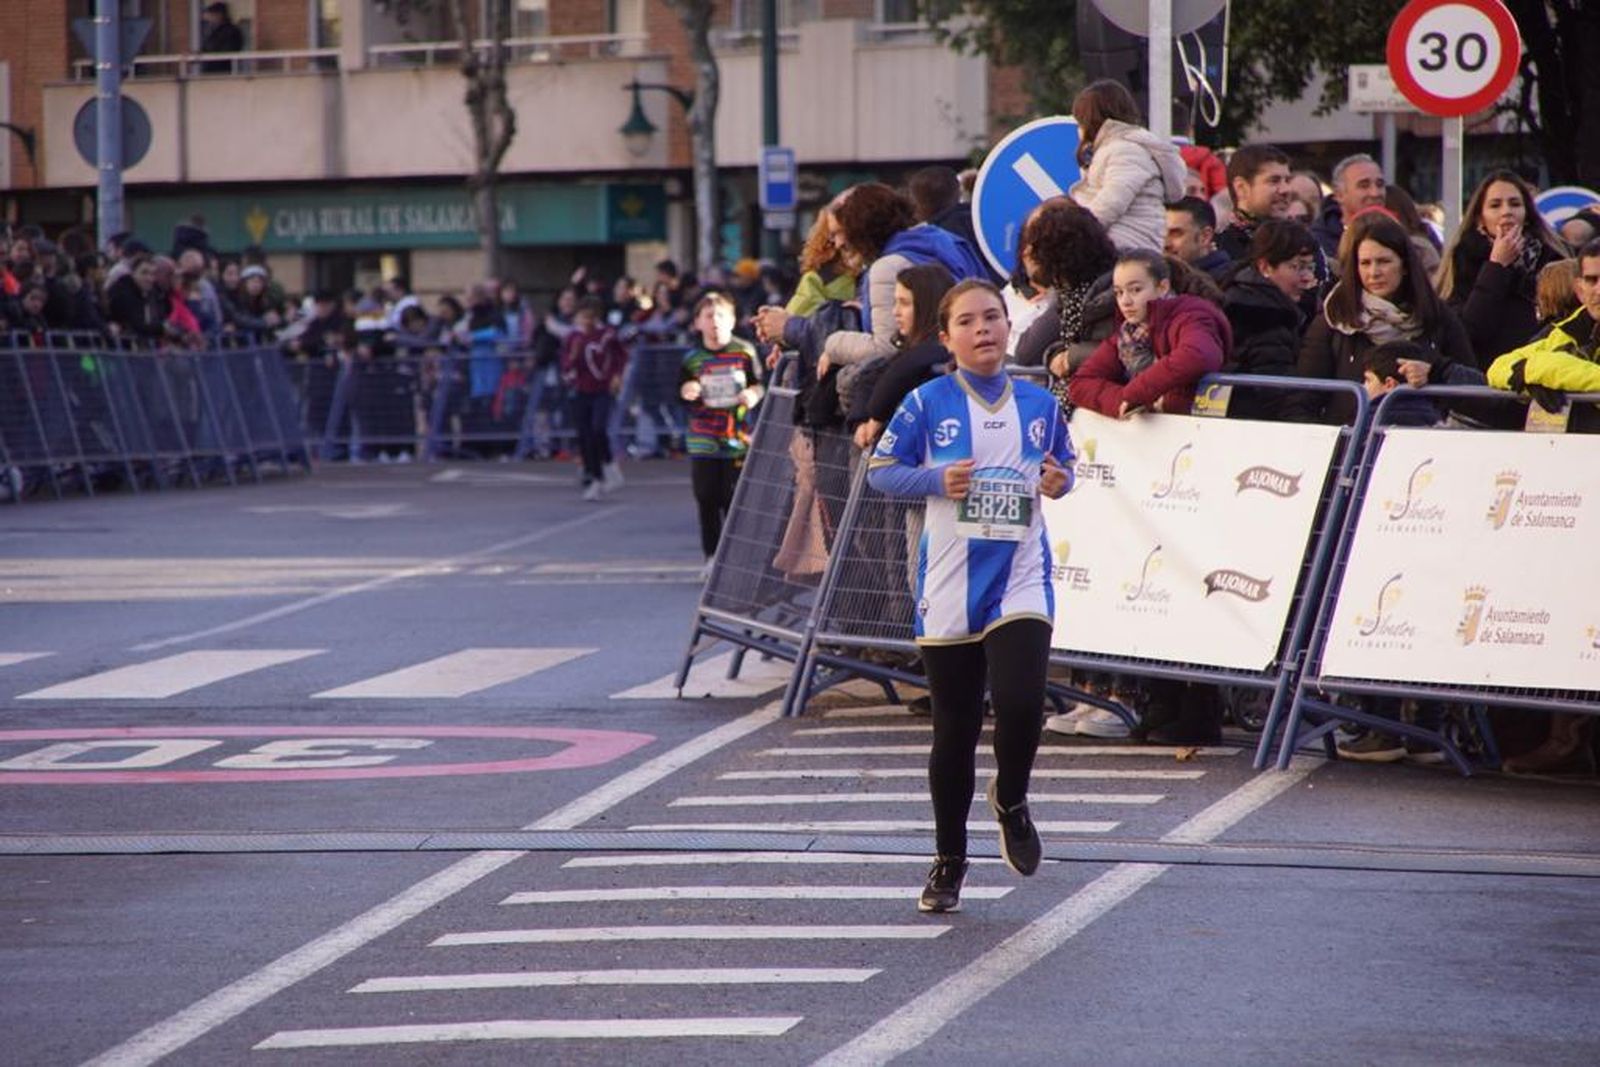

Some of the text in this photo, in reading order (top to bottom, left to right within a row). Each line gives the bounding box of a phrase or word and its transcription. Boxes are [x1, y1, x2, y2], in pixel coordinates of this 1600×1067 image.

[1418, 31, 1489, 73] 30
[967, 494, 1021, 521] 5828
[1517, 491, 1583, 510] Ayuntamiento
[1486, 605, 1552, 625] Ayuntamiento
